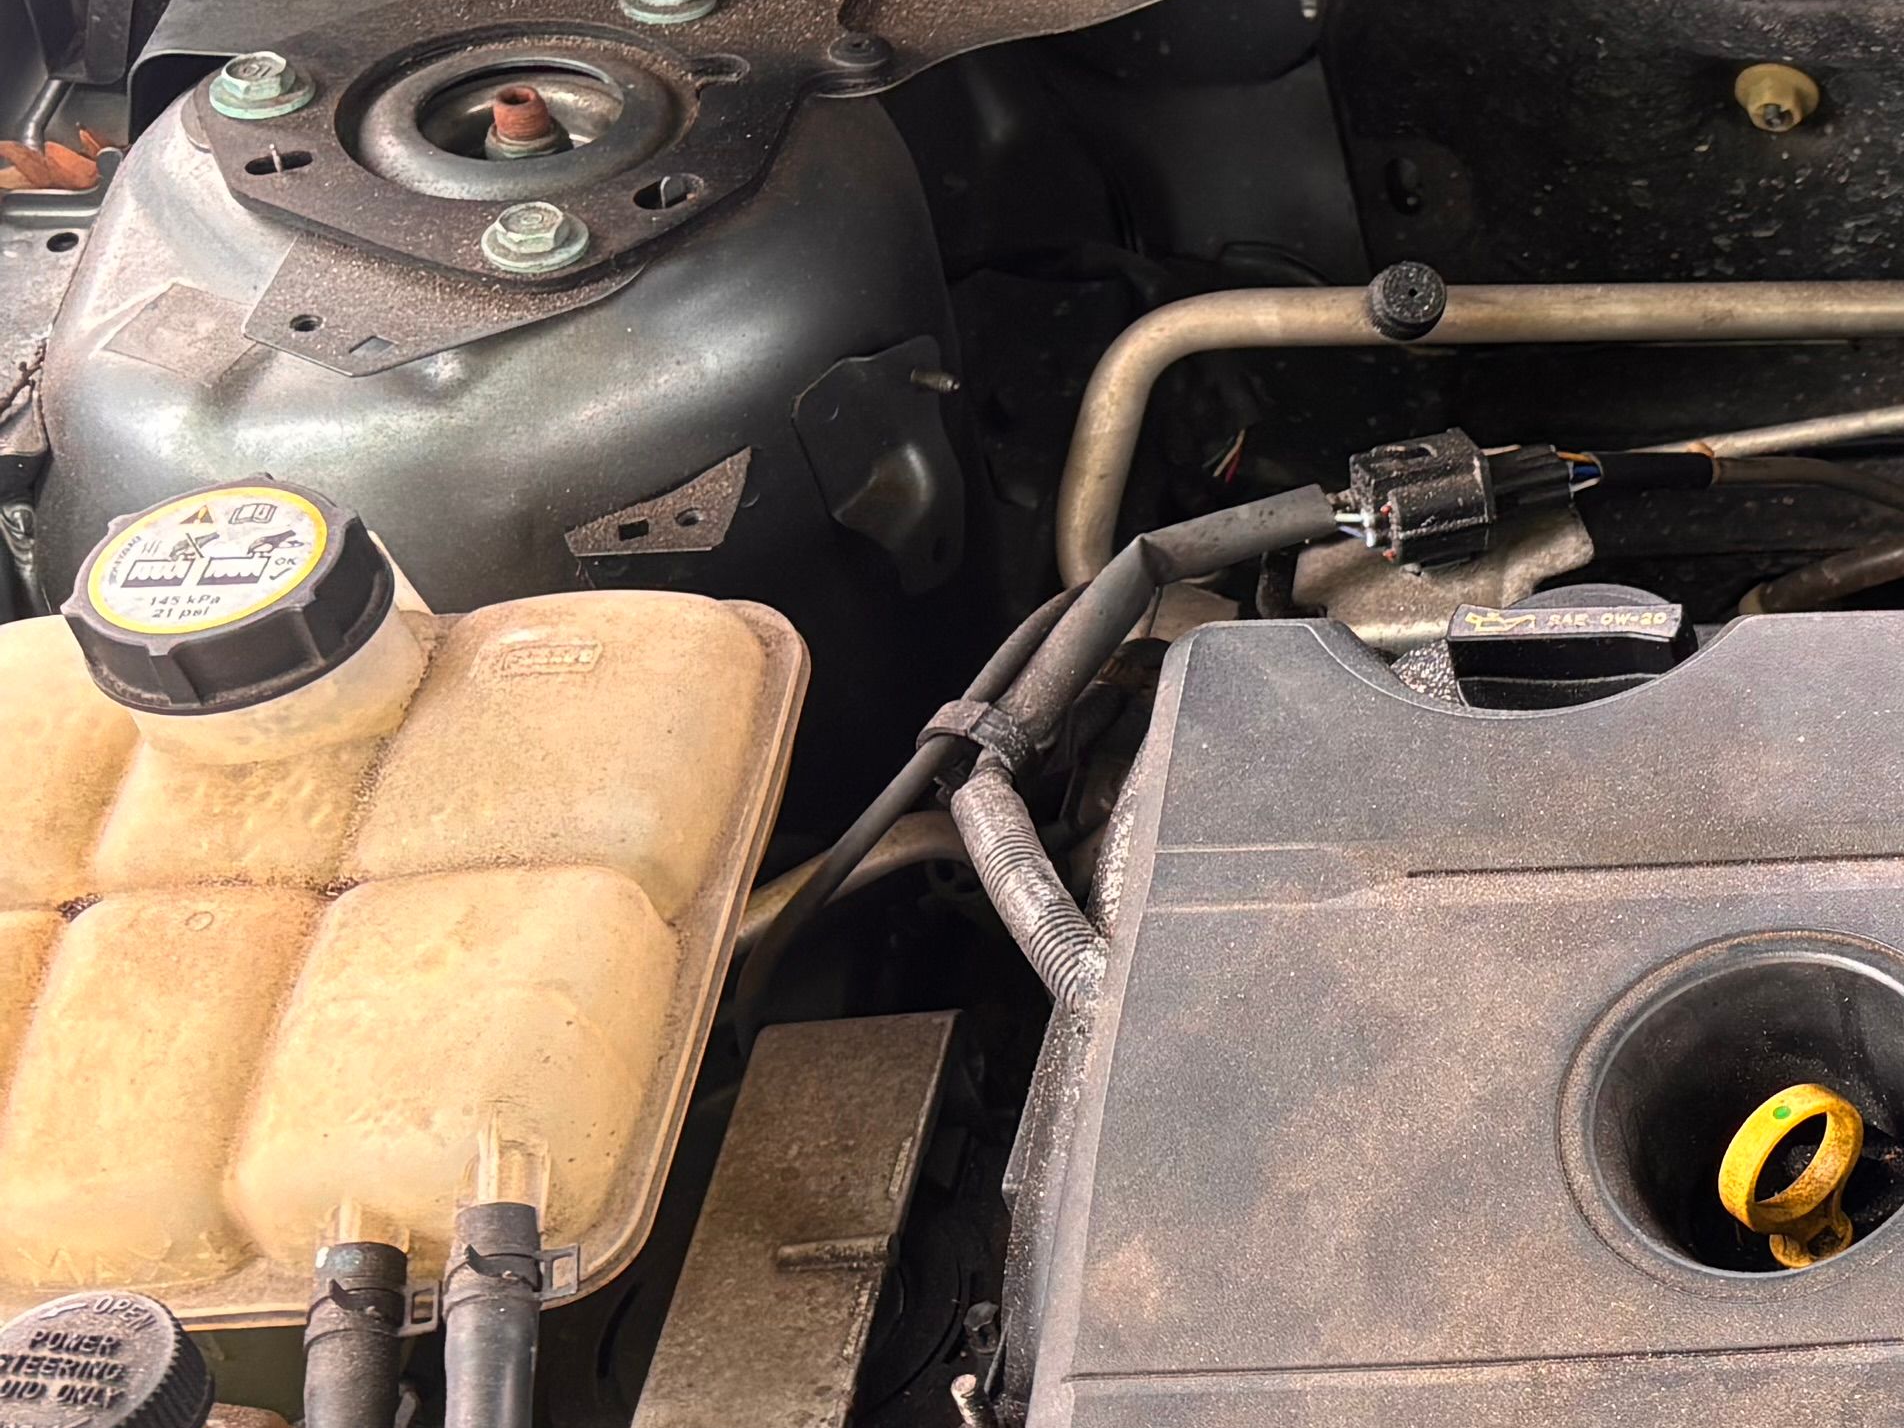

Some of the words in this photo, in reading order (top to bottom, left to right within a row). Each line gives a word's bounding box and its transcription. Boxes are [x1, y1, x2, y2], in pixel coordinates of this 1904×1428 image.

[274, 556, 297, 567] OK
[186, 593, 221, 605] kPa
[151, 607, 175, 618] 21
[1546, 612, 1588, 627] SAE
[1599, 610, 1667, 627] 0W-20
[92, 1294, 158, 1333] OPEN
[28, 1329, 123, 1356] POWER
[56, 1383, 126, 1411] ONLY
